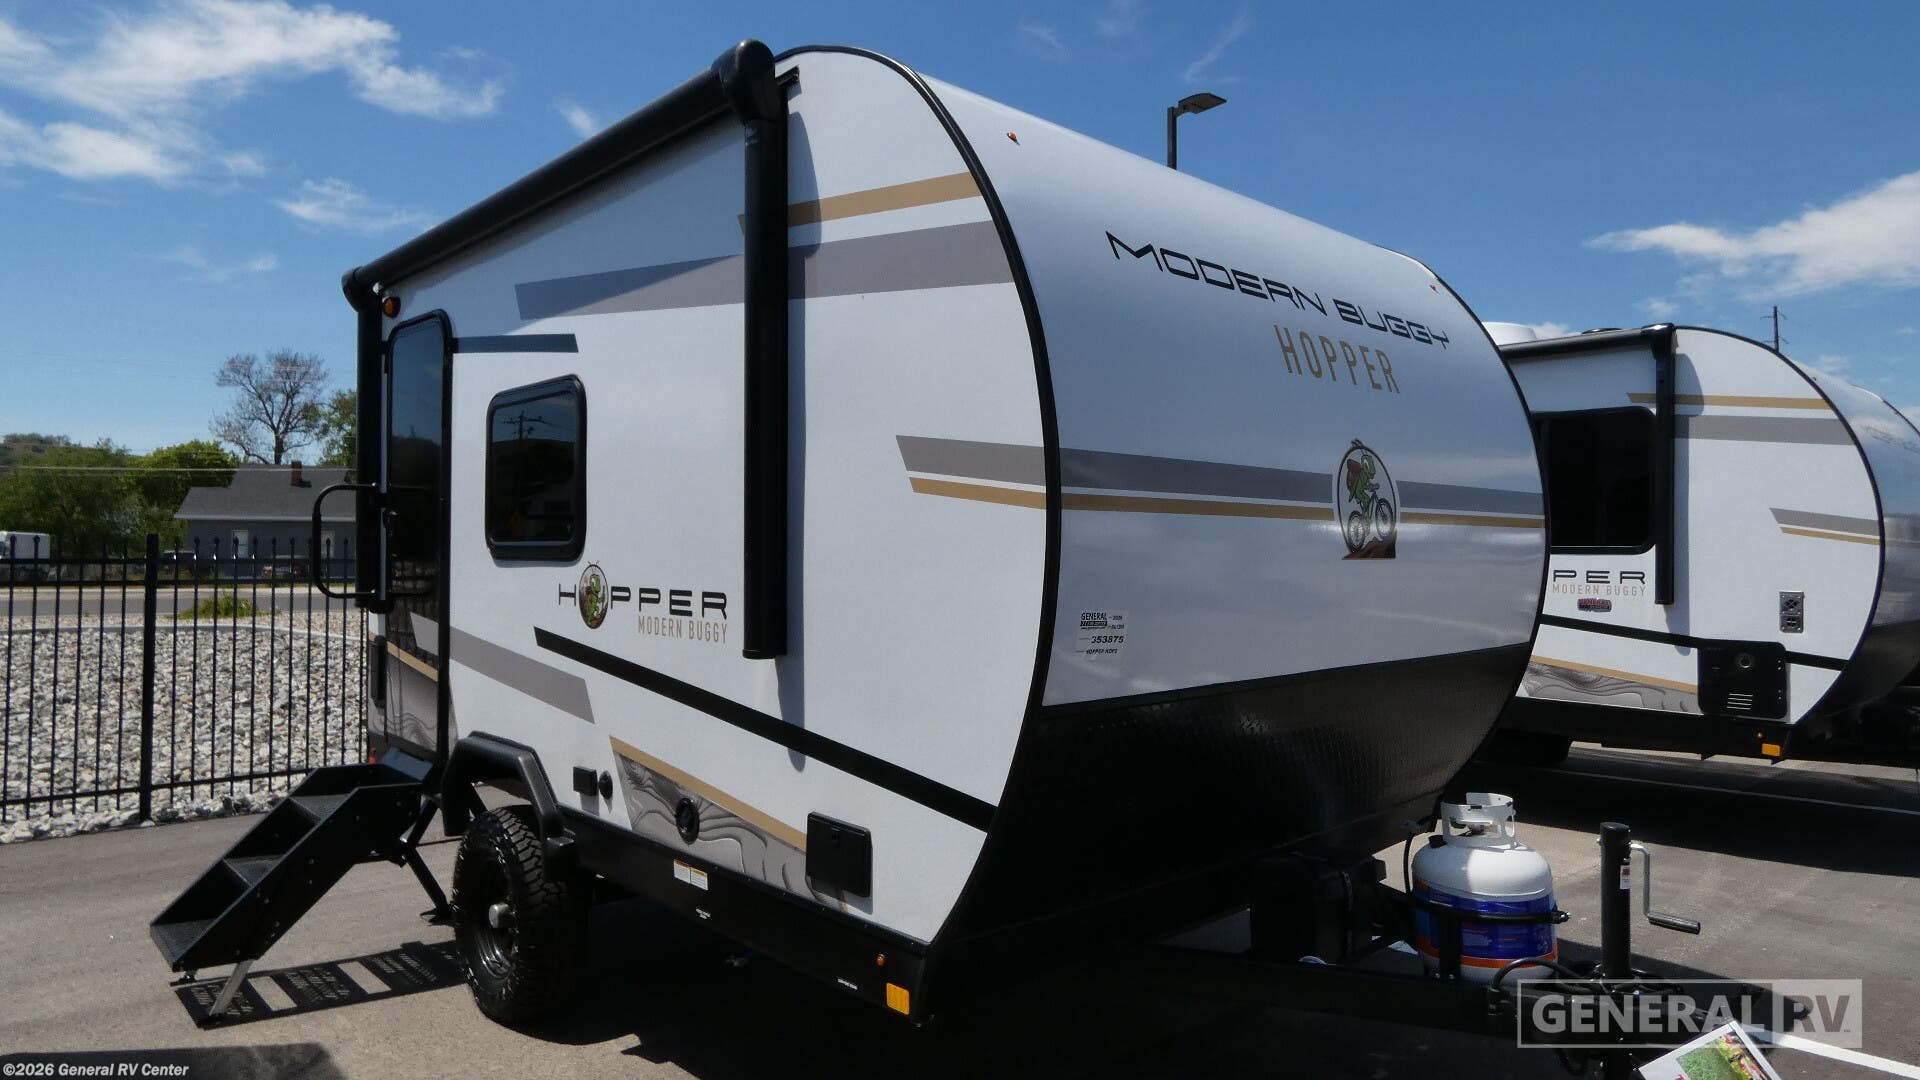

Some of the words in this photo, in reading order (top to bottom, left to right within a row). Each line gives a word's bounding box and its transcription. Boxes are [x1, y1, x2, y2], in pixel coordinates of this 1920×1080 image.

[1105, 230, 1327, 317] MODERN
[1333, 298, 1450, 350] BUGGY
[1273, 324, 1401, 394] HOPPER
[1552, 584, 1600, 596] MODERN
[1606, 585, 1646, 597] BUGGY
[638, 616, 683, 639] MODERN
[688, 620, 728, 645] BUGGY
[1091, 635, 1124, 644] 353875
